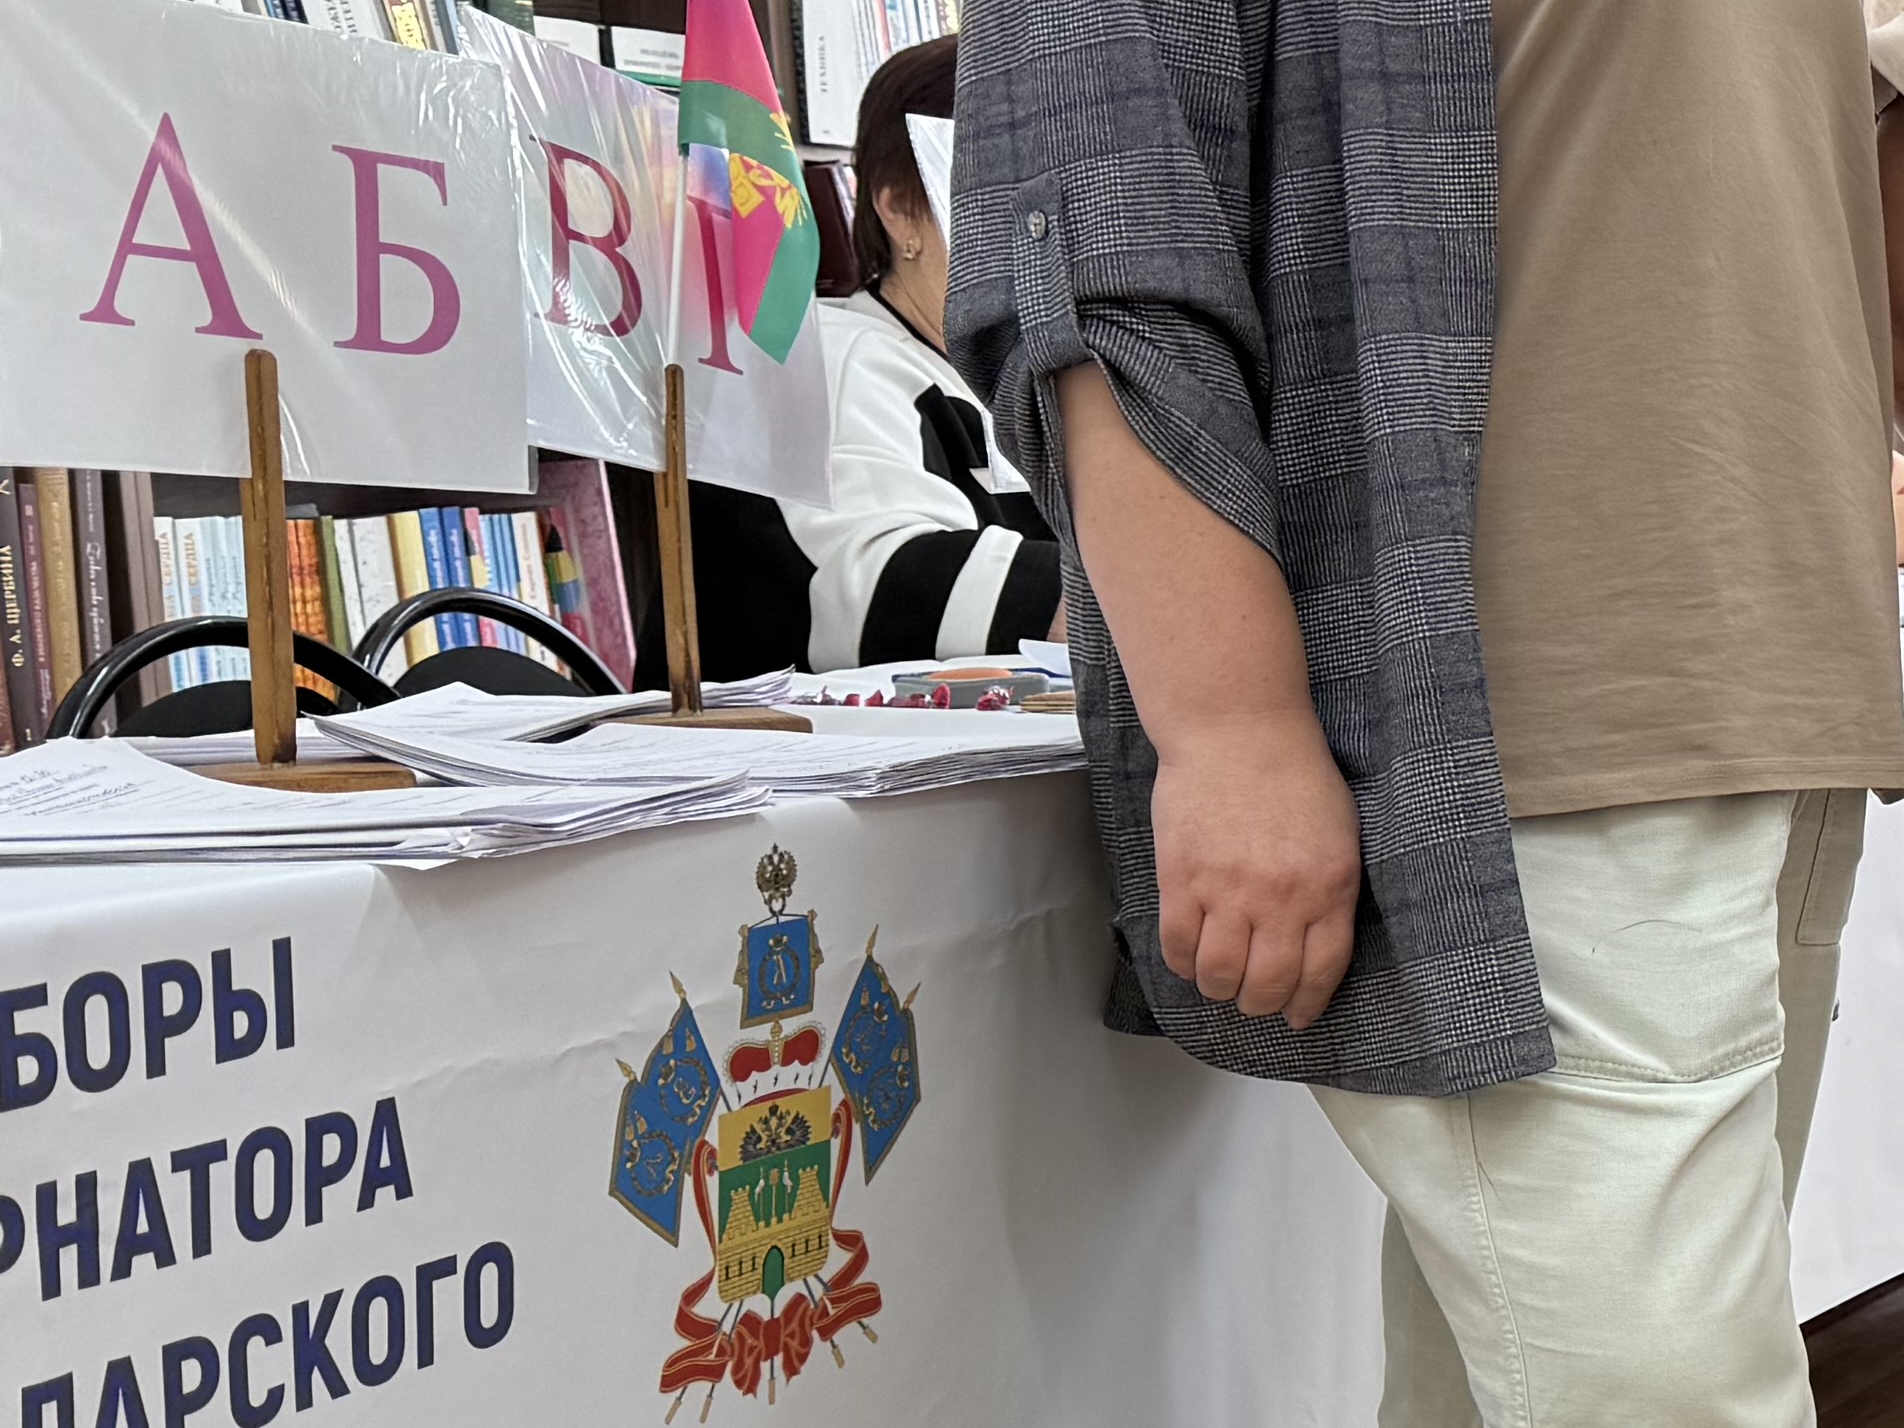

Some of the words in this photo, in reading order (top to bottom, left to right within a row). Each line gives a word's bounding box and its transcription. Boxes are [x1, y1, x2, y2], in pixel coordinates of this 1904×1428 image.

[80, 112, 264, 340] А
[332, 143, 461, 356] Б
[529, 133, 643, 339] В
[0, 545, 21, 625] ЩЕРБИНА
